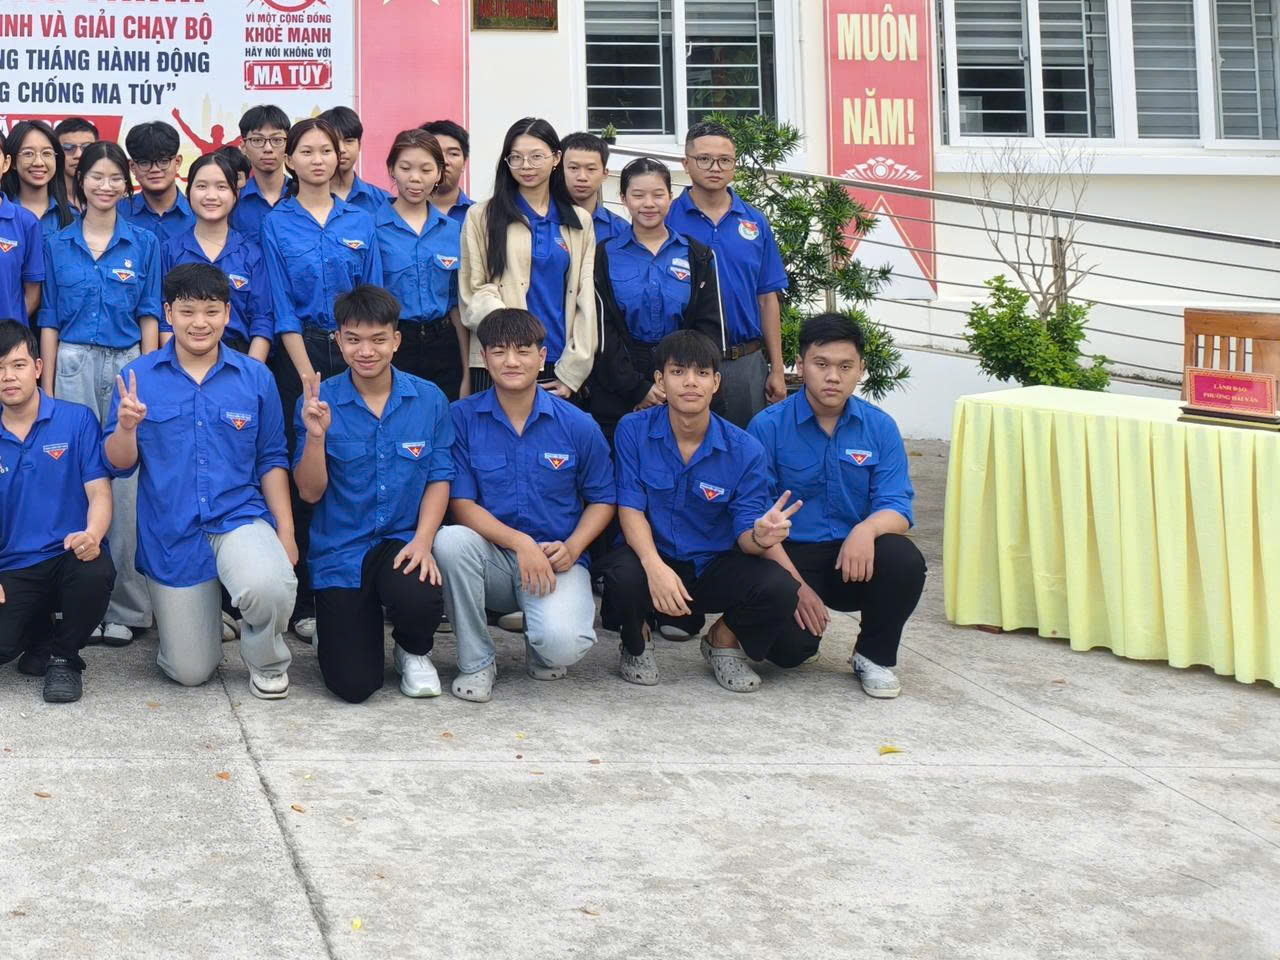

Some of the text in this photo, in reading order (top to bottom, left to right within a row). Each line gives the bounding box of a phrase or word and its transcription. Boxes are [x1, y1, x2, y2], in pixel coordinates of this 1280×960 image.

[40, 10, 67, 37] VÀ
[74, 9, 115, 38] GIẢI
[123, 16, 178, 44] CHẠY
[185, 13, 213, 45] BỘ
[258, 11, 277, 25] MỘT
[280, 12, 304, 25] CỘNG
[288, 27, 332, 46] MẠNH
[836, 5, 918, 62] MUÔN
[26, 45, 90, 72] THÁNG
[97, 46, 150, 72] HÀNH
[157, 48, 210, 76] ĐỘNG
[245, 46, 332, 58] HÃY NÓI KHÔNG VỚI
[254, 61, 323, 86] MA TÚY
[18, 74, 84, 104] CHỐNG
[91, 83, 121, 104] MA
[842, 87, 915, 147] NĂM!
